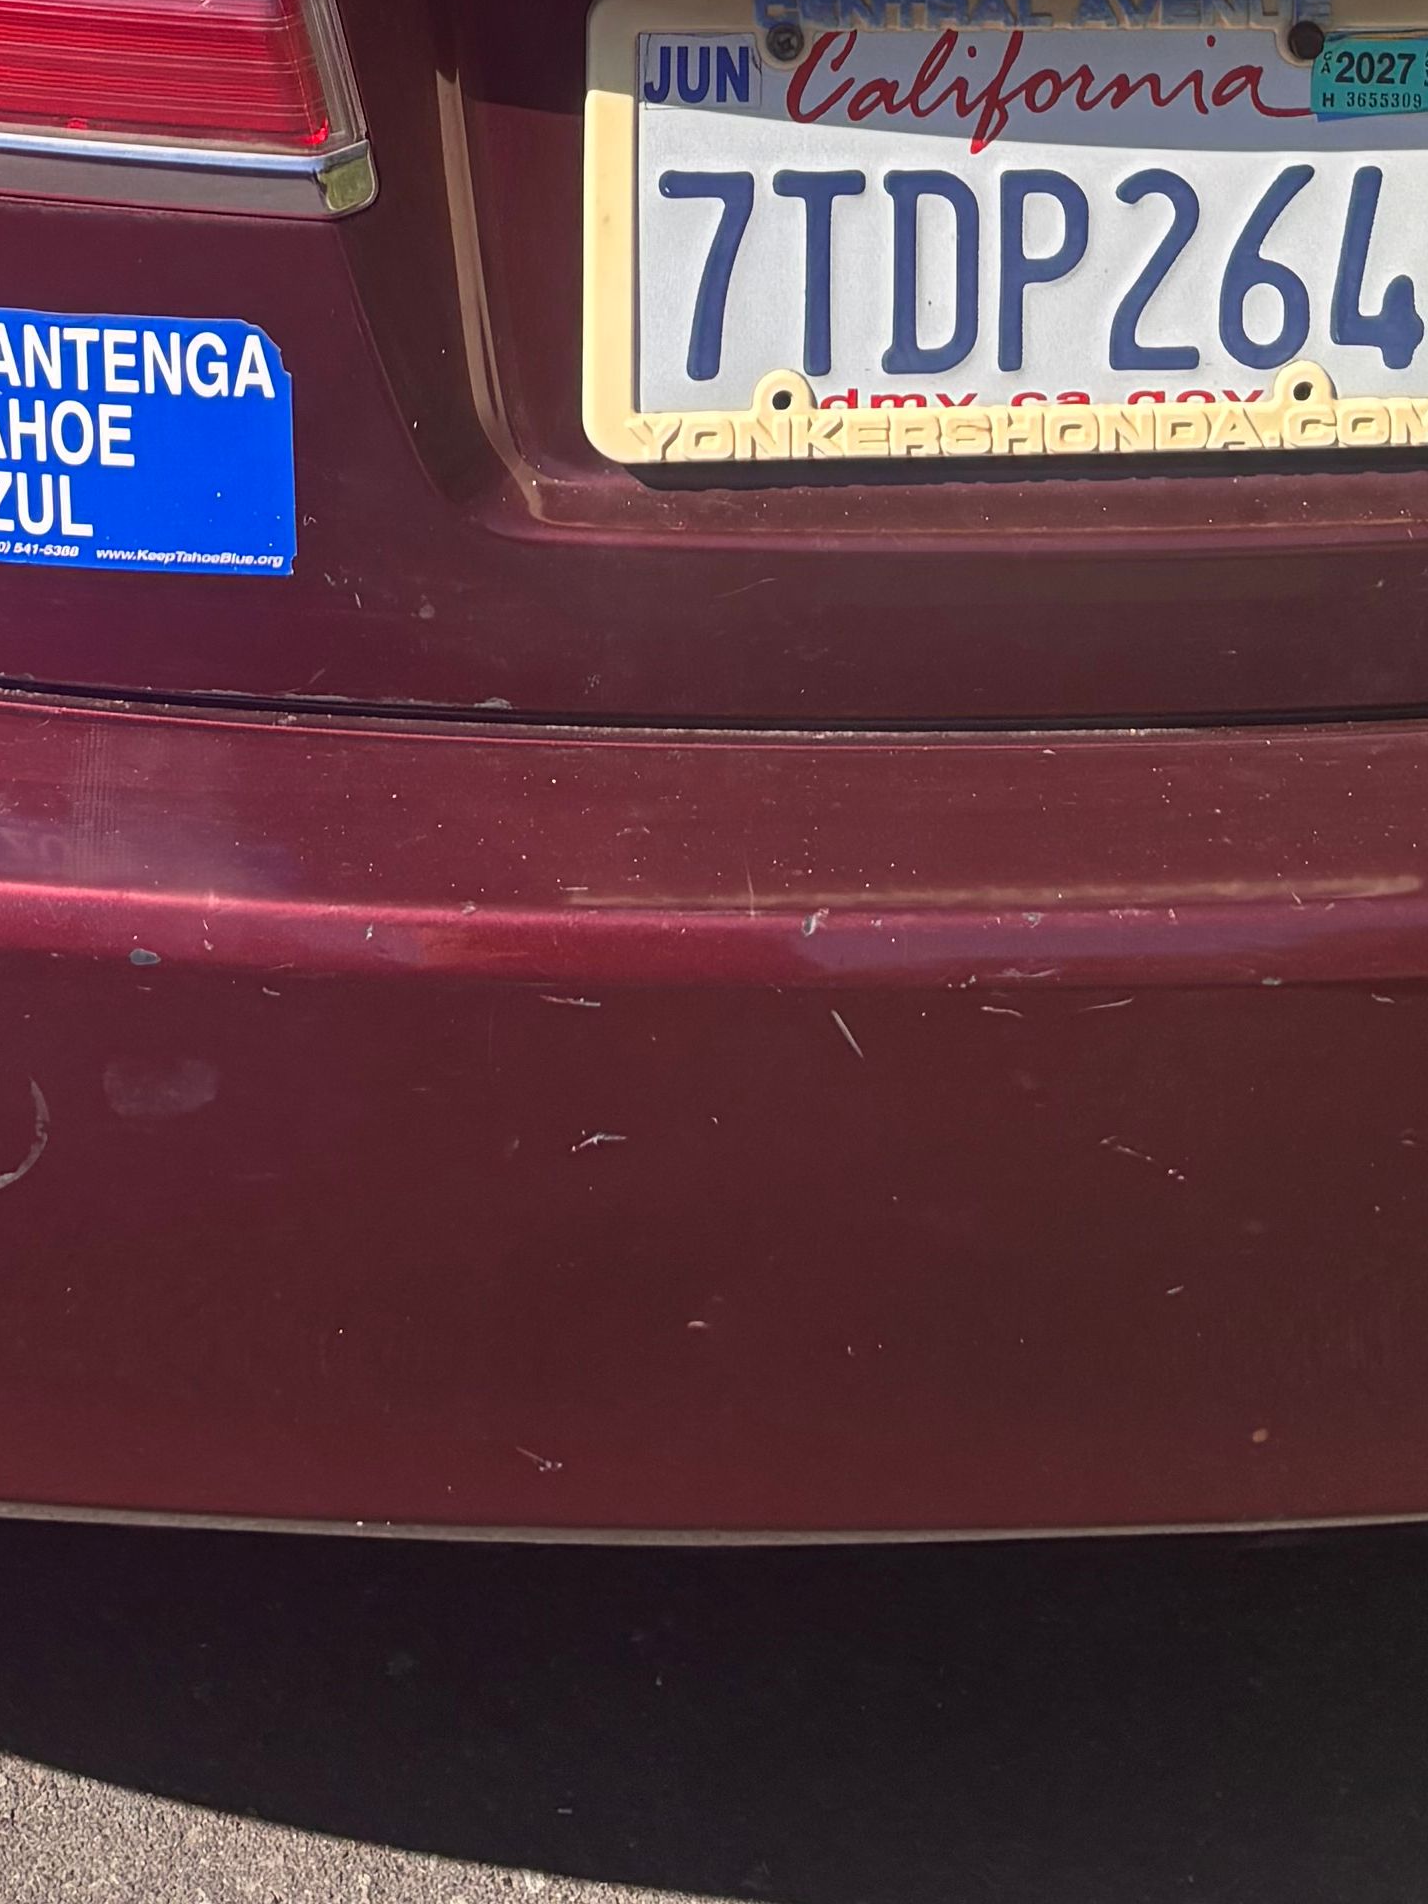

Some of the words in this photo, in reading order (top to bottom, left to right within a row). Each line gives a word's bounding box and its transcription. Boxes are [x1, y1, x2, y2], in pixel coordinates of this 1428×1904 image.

[642, 44, 752, 105] JUN
[1334, 50, 1417, 85] 2027
[785, 29, 1314, 155] California
[1322, 93, 1335, 107] H
[1346, 91, 1422, 110] 3655309
[657, 162, 1425, 382] 7TDP264
[818, 388, 1266, 410] dmvcaov
